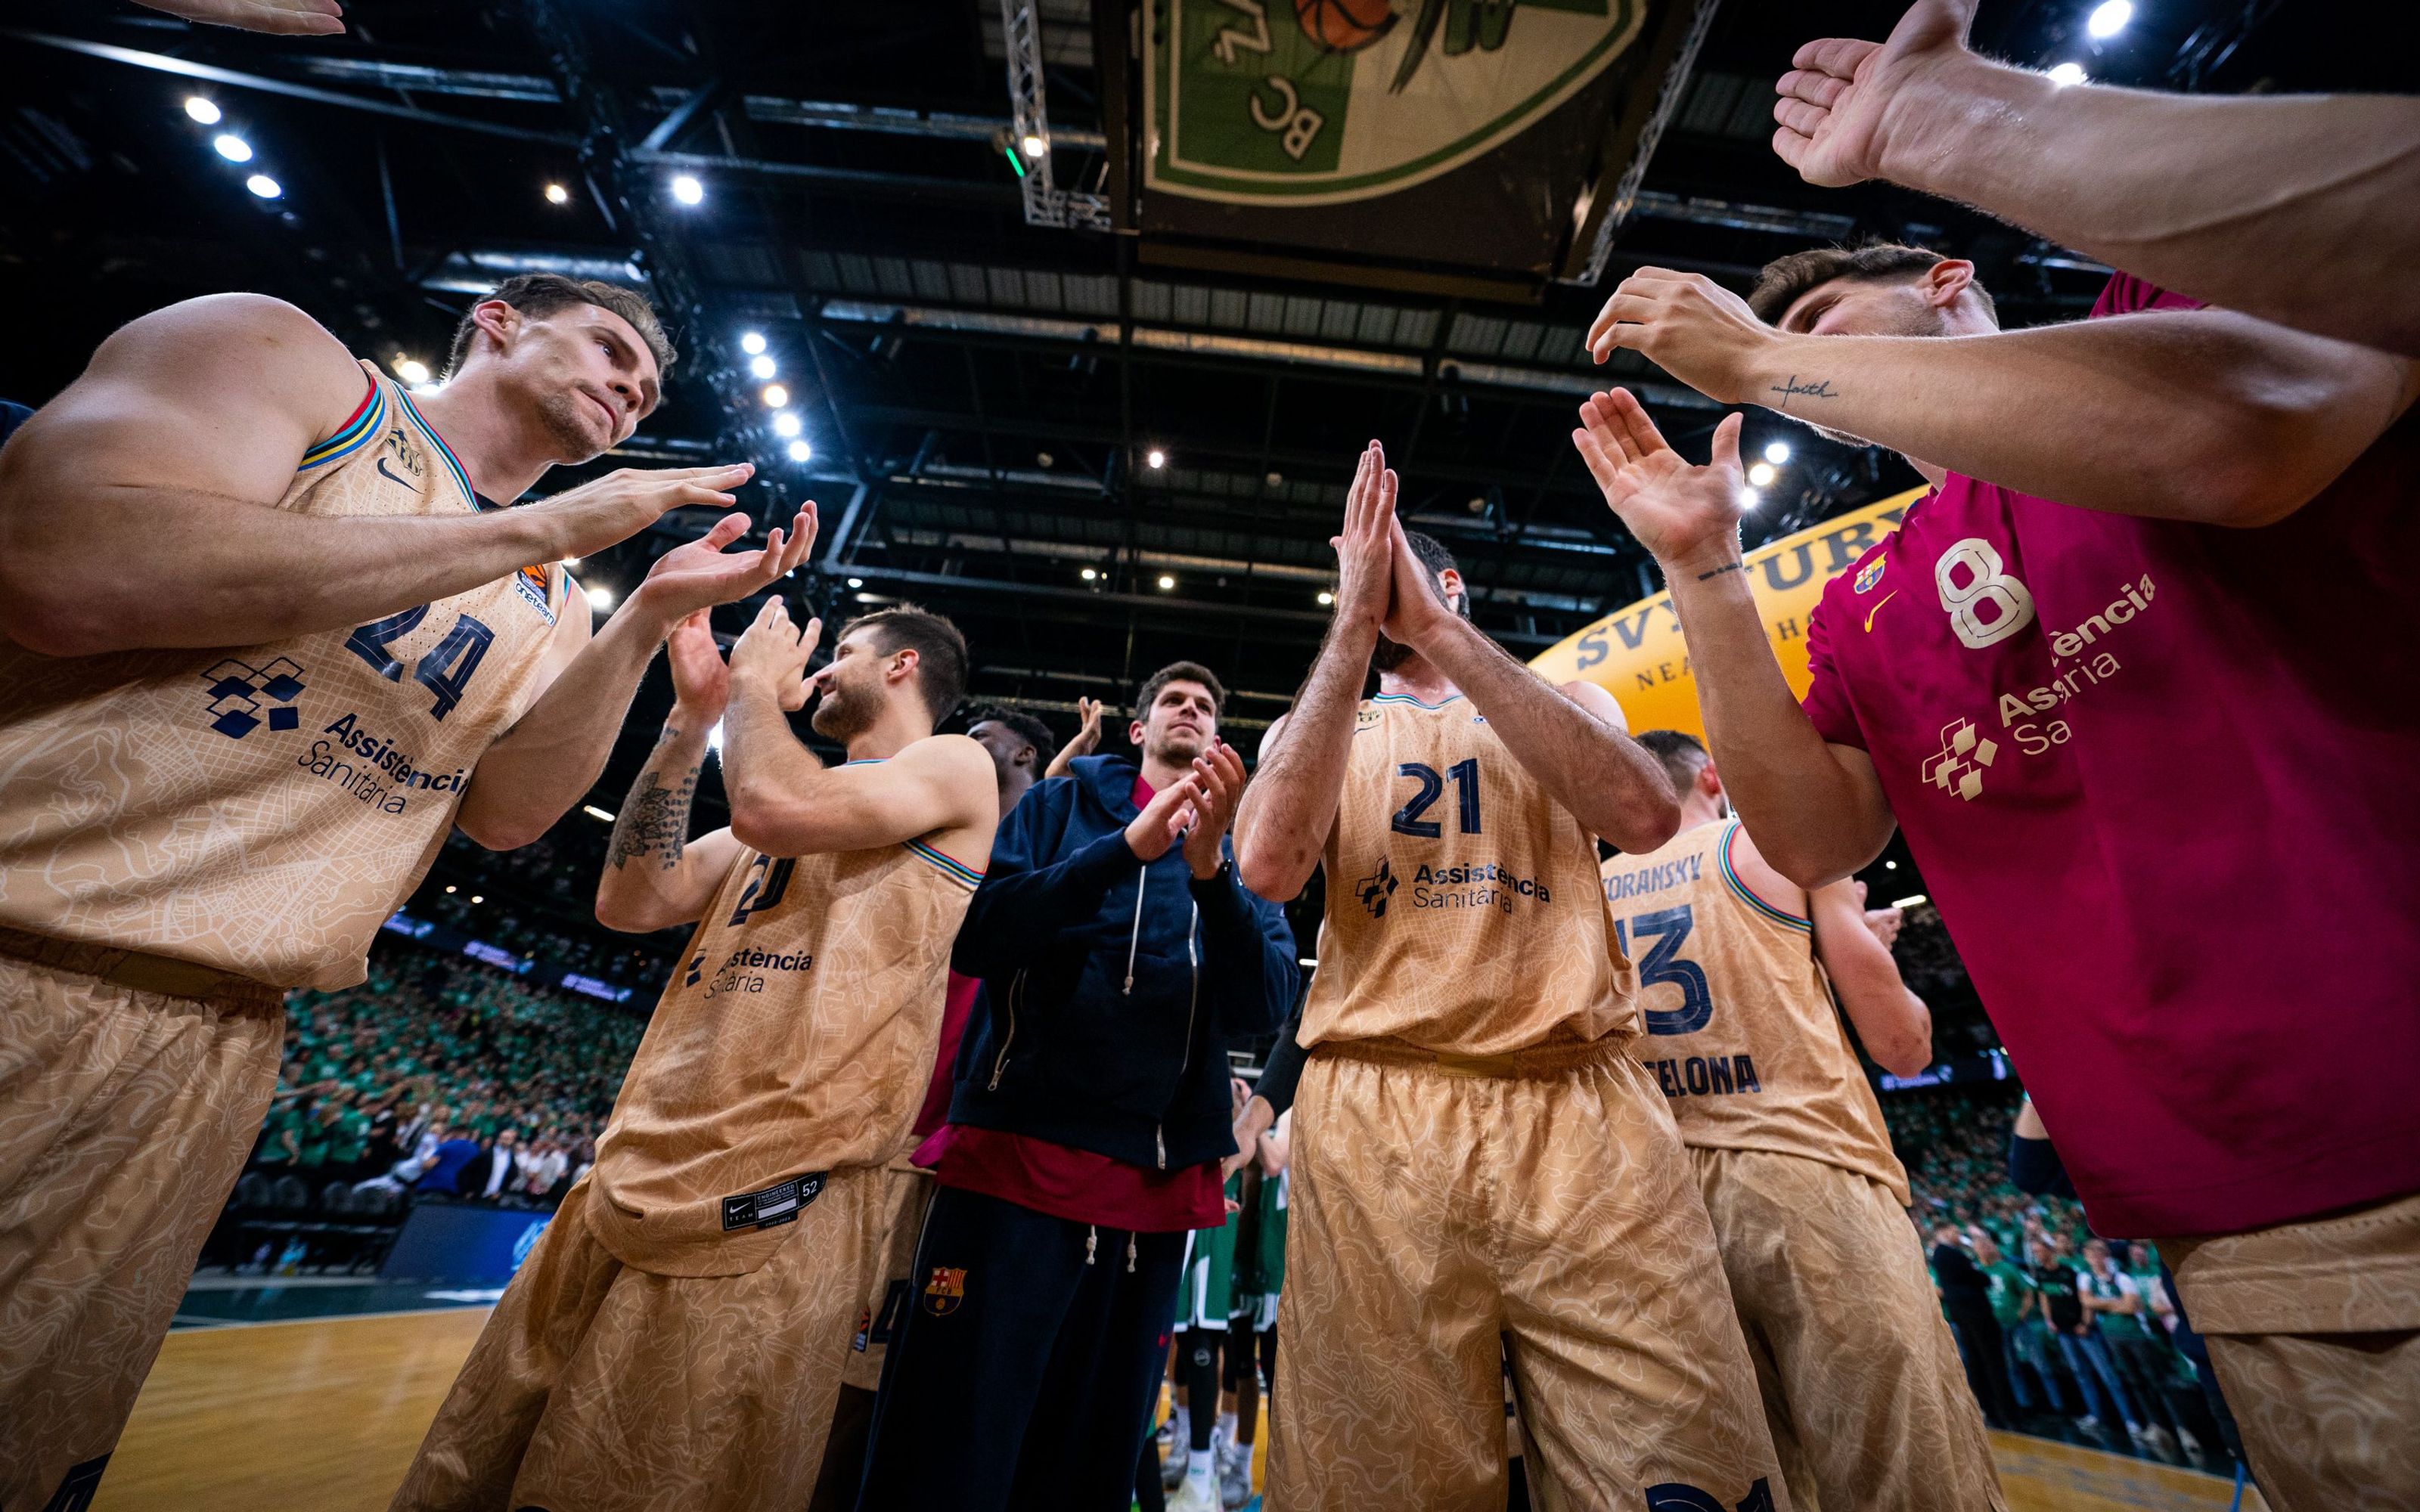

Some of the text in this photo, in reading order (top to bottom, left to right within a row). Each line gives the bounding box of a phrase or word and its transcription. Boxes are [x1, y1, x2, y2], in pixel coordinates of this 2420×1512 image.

[1250, 77, 1323, 160] BC
[515, 583, 554, 624] oneteam
[1934, 538, 2036, 649] 8
[344, 604, 495, 722] 24
[298, 740, 406, 814] Sanitària
[1391, 758, 1481, 838] 21
[1413, 862, 1550, 903] Assistència
[1413, 886, 1512, 915] Sanitària
[758, 1184, 795, 1201] ENGINEERED
[802, 1180, 818, 1197] 52
[730, 1212, 753, 1222] TEAM
